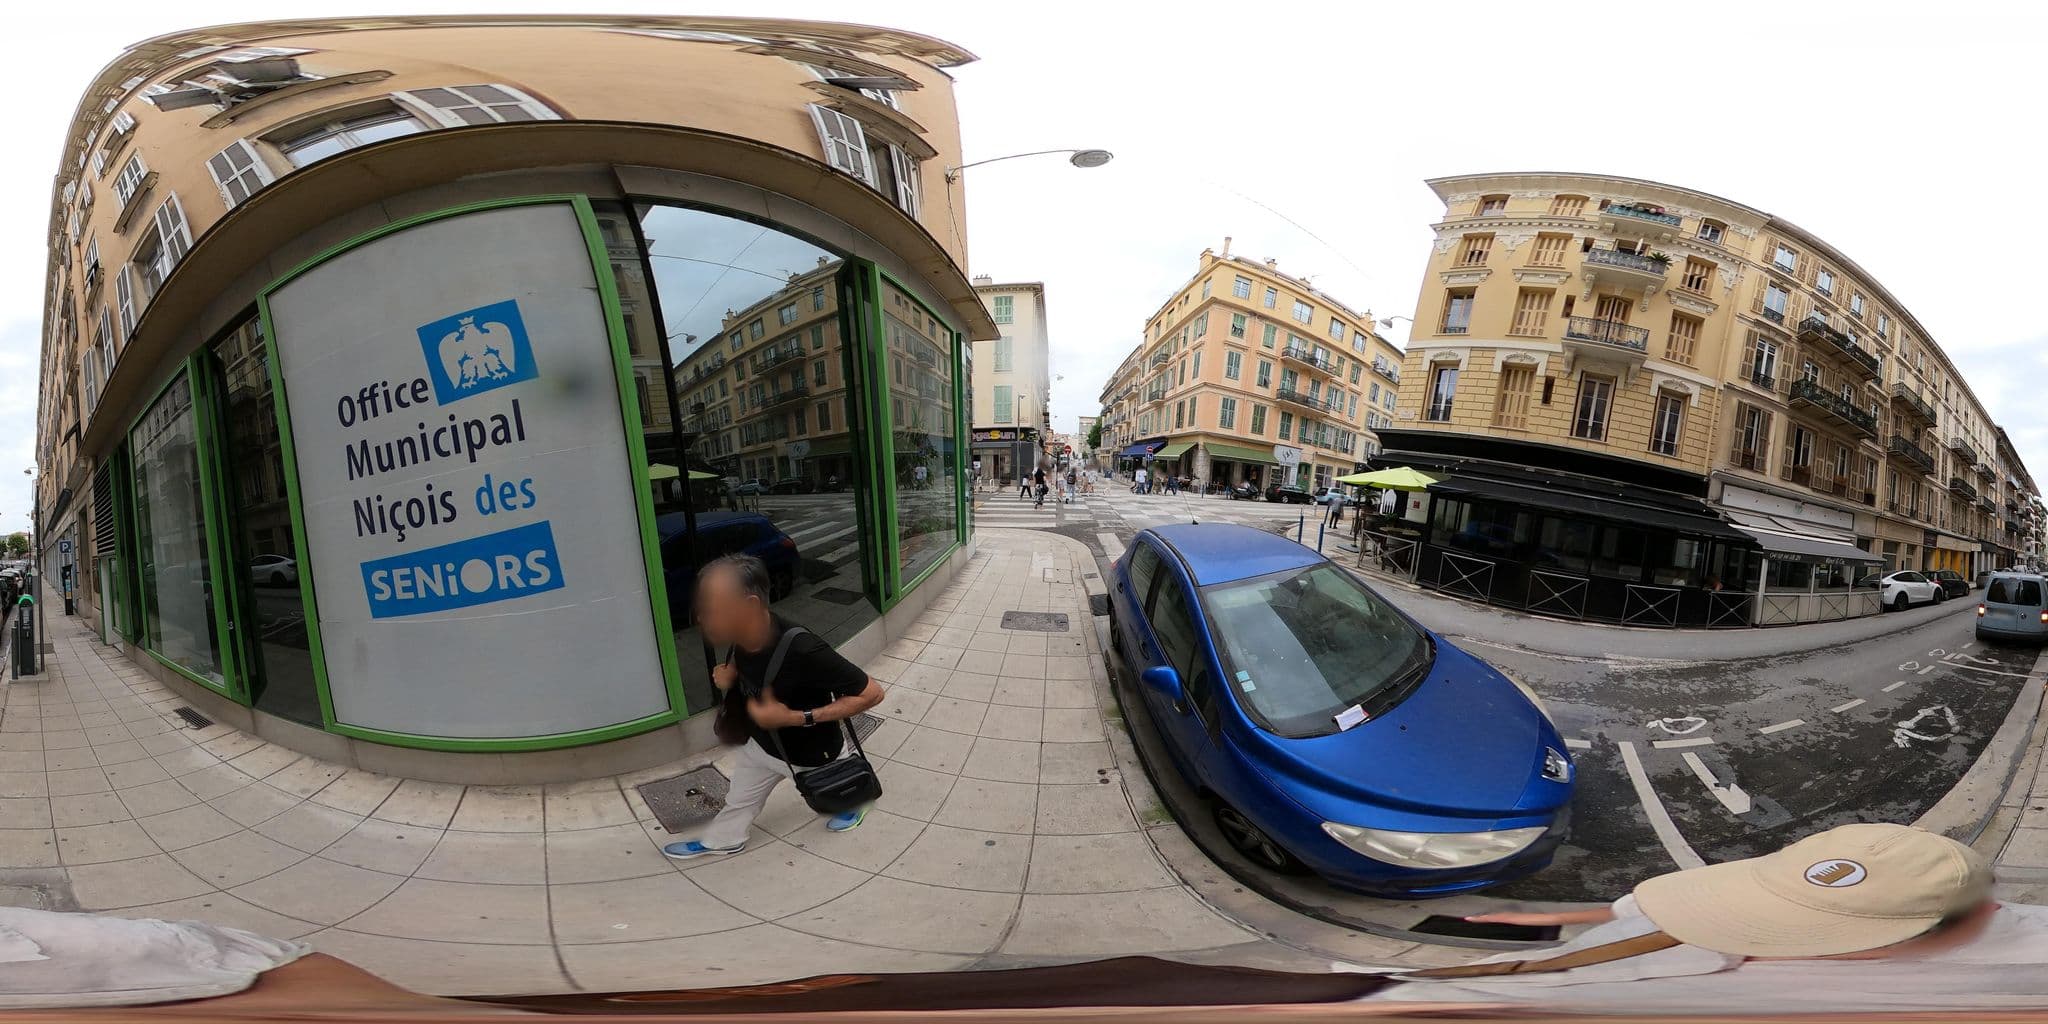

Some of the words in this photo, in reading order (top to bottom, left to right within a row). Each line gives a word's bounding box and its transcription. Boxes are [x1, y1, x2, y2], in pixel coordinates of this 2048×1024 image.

[337, 377, 430, 428] Office
[346, 398, 526, 481] Municipal
[353, 483, 457, 543] Niçois
[475, 473, 537, 516] des
